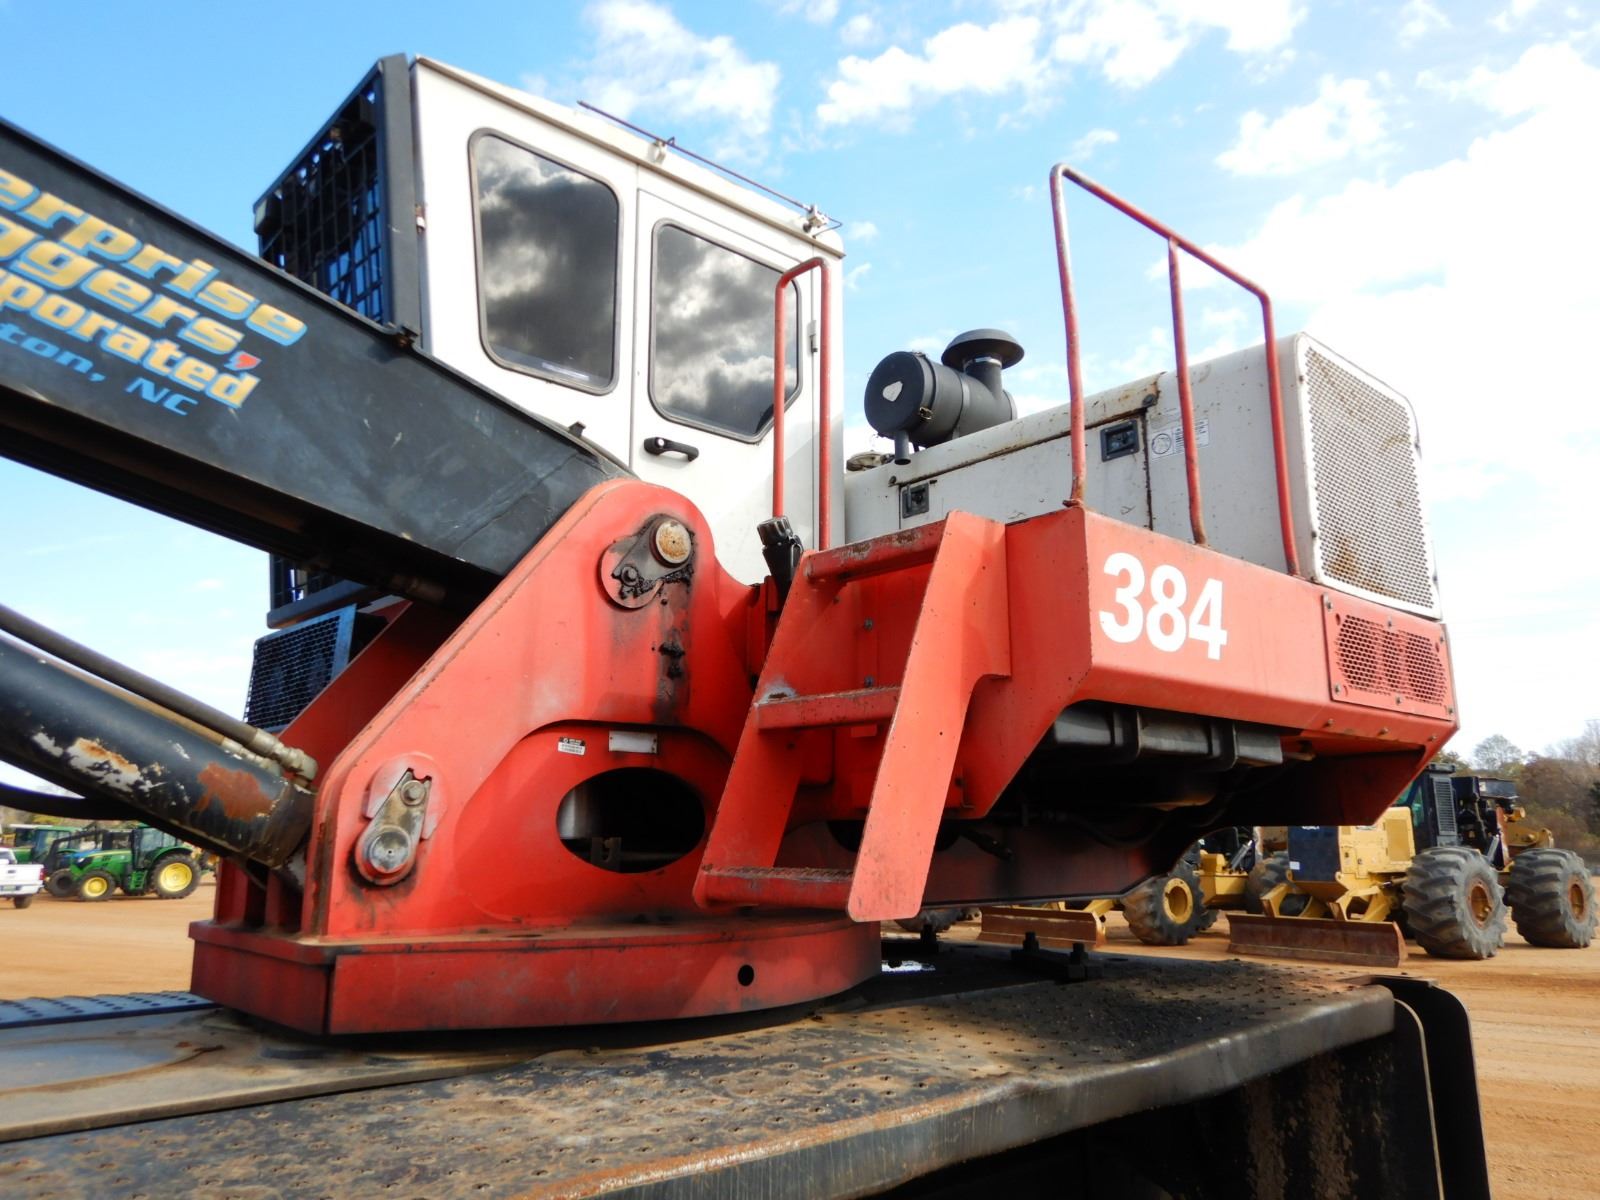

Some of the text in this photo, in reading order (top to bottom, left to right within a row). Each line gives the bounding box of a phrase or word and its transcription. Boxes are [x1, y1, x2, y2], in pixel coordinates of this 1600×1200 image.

[0, 266, 261, 409] porated
[124, 377, 199, 416] NC
[1098, 552, 1228, 661] 384
